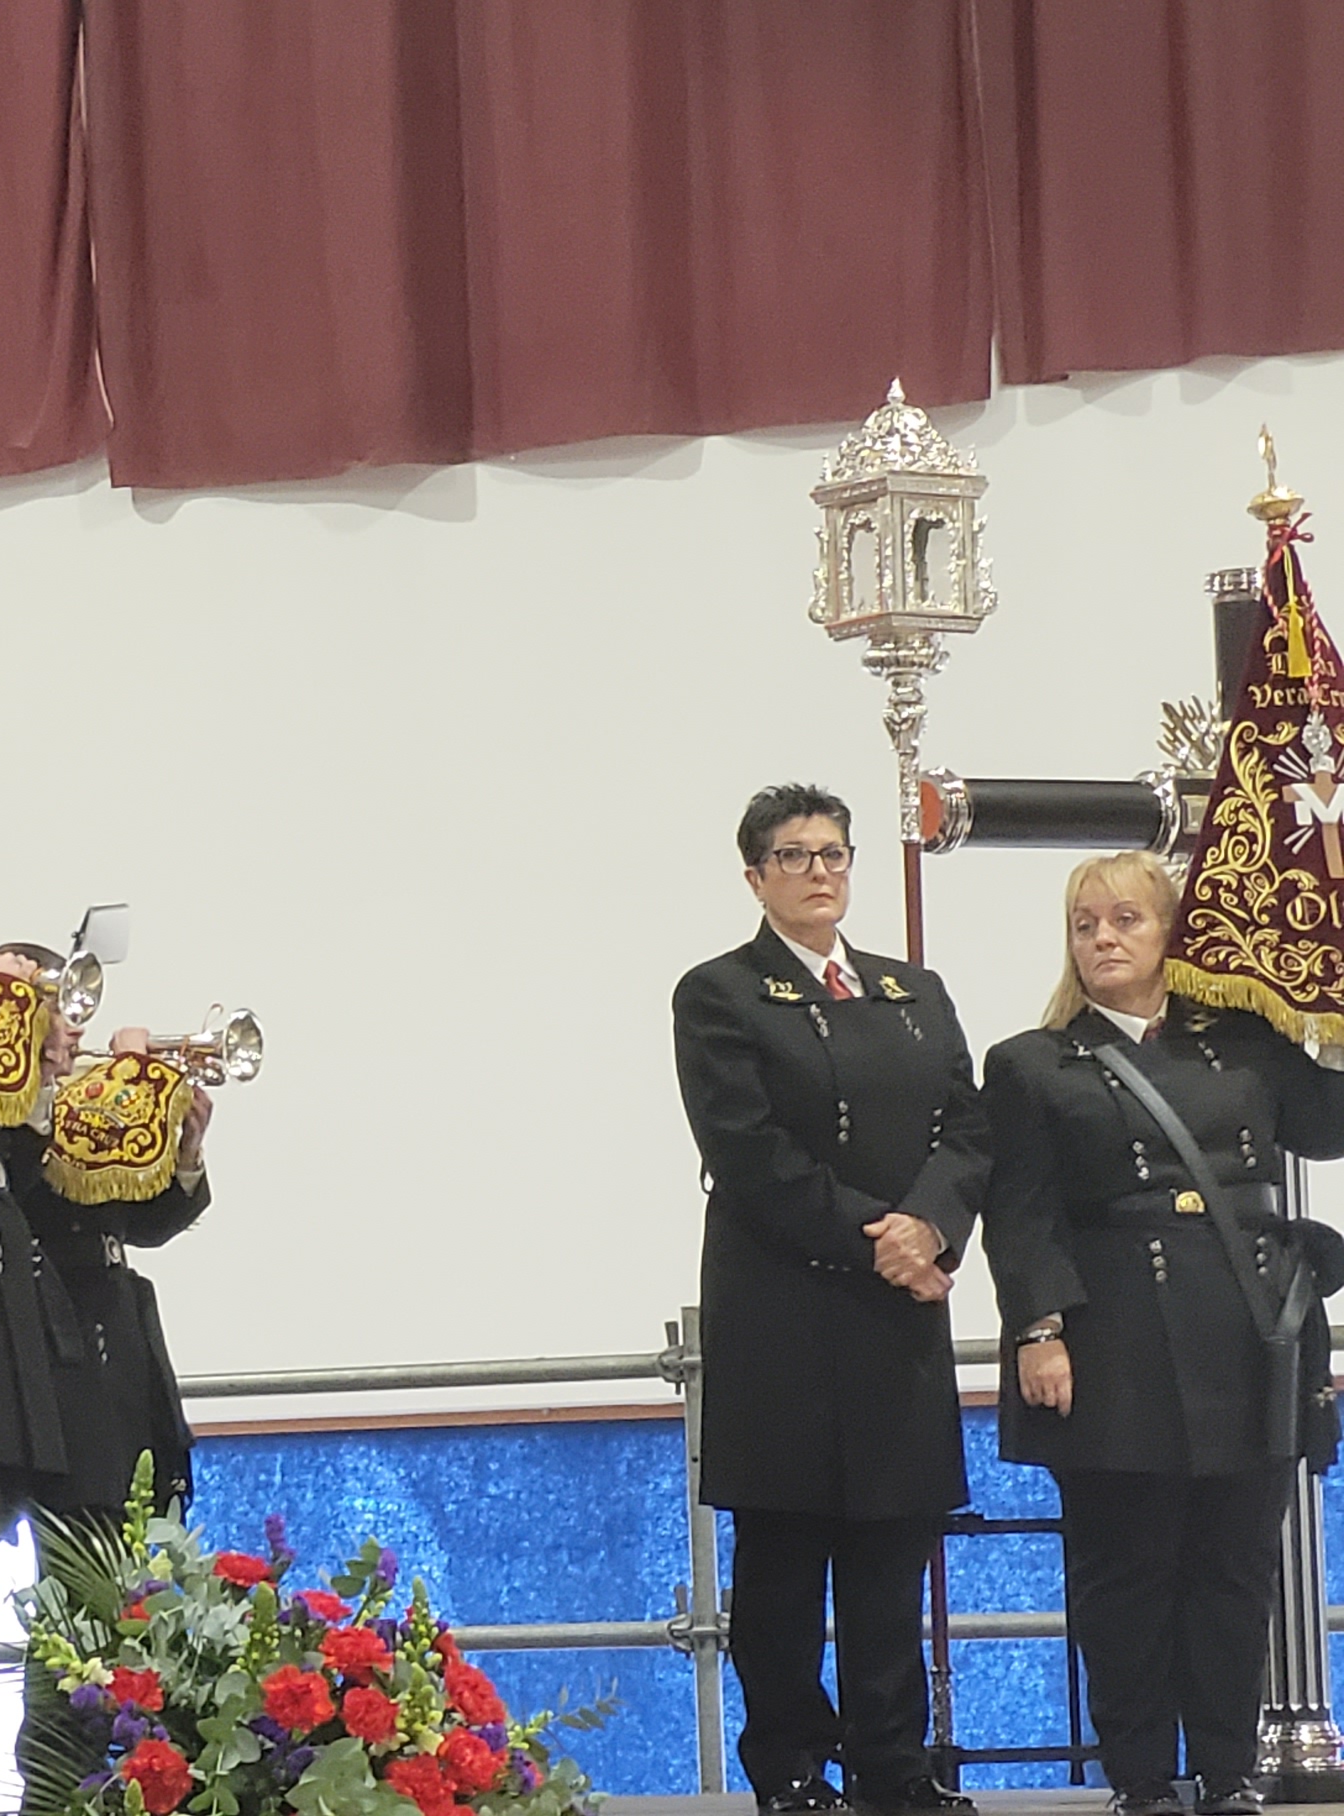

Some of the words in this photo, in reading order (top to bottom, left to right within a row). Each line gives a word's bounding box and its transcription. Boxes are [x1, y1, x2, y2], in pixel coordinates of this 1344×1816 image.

[1247, 682, 1309, 709] Vera
[1316, 682, 1344, 707] Cr
[1285, 890, 1344, 931] Ol
